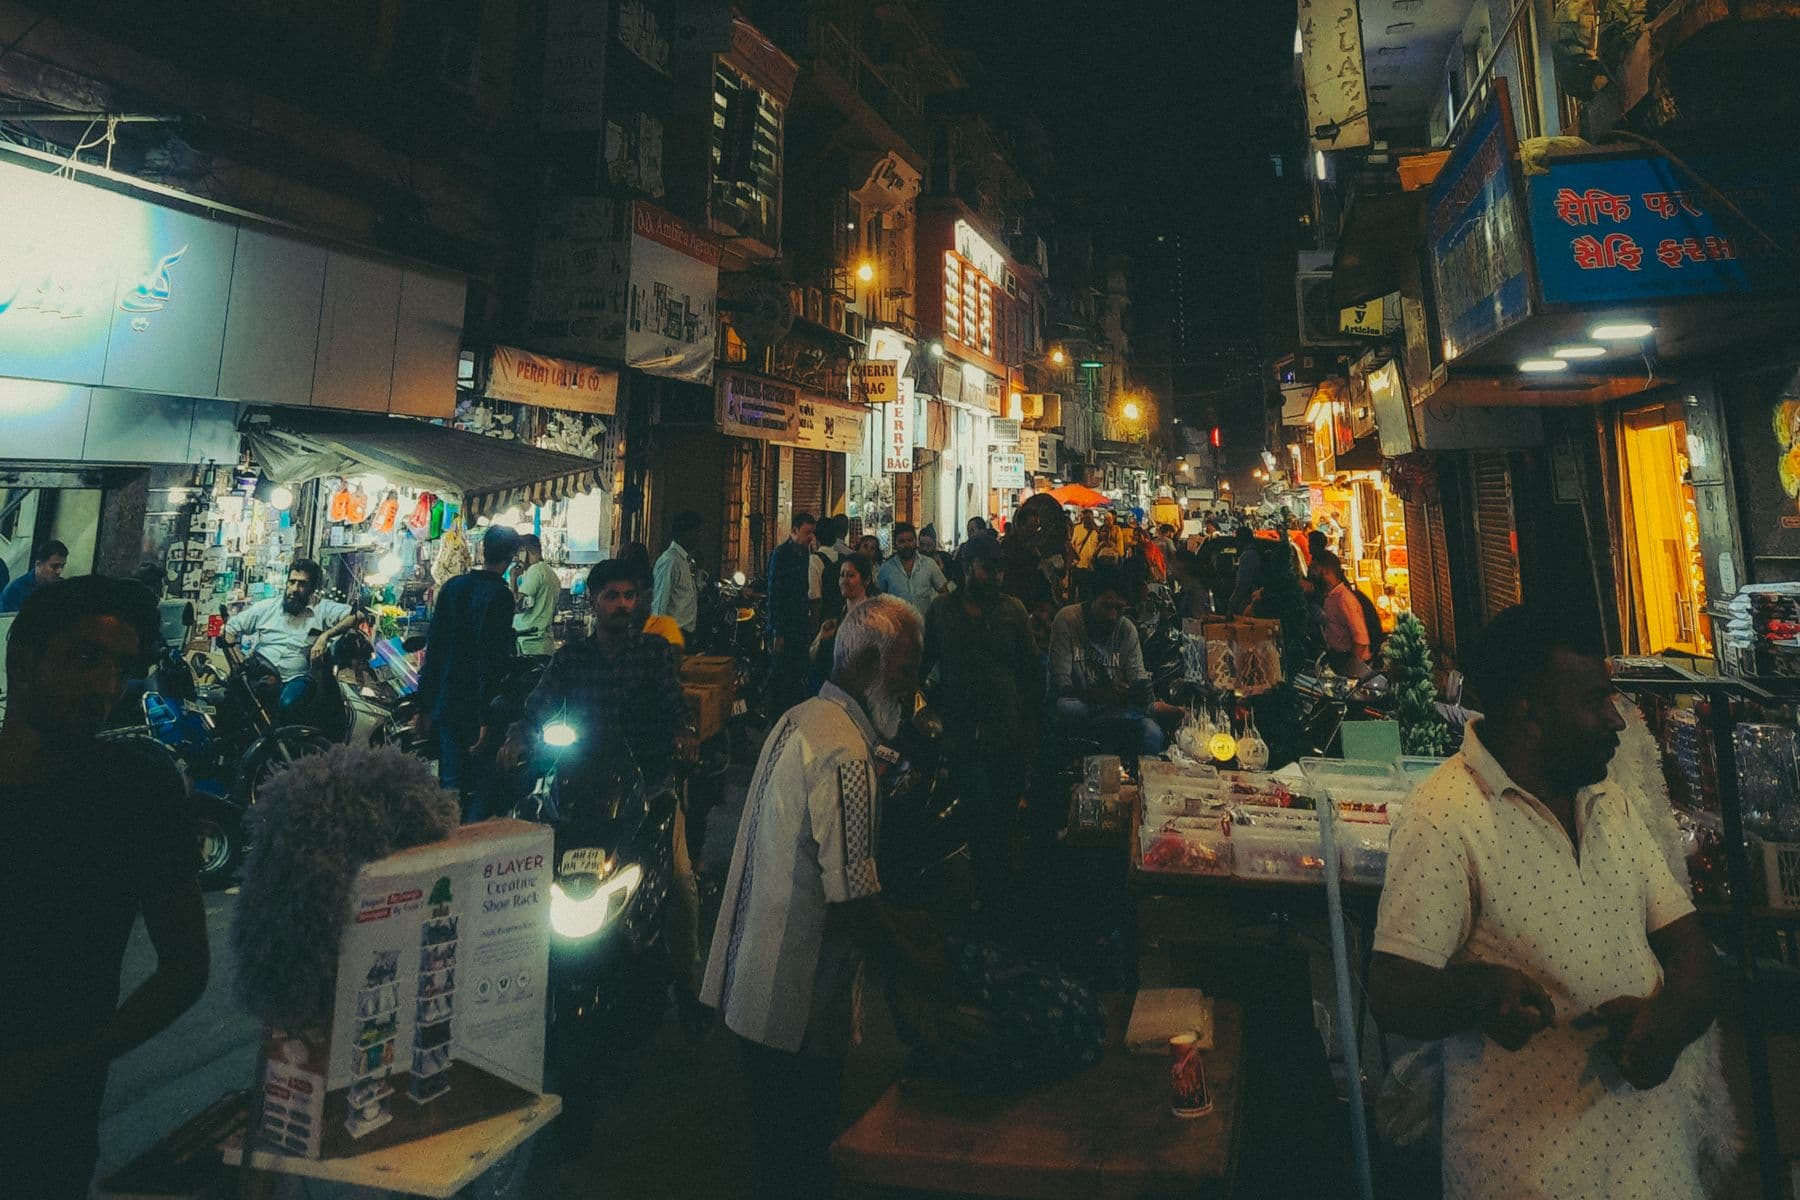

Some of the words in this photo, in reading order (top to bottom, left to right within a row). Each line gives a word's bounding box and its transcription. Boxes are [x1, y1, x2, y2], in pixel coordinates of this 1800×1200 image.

[851, 364, 896, 378] CHERRY
[887, 457, 910, 470] BAG
[483, 863, 494, 879] 8
[497, 855, 545, 876] LAYER
